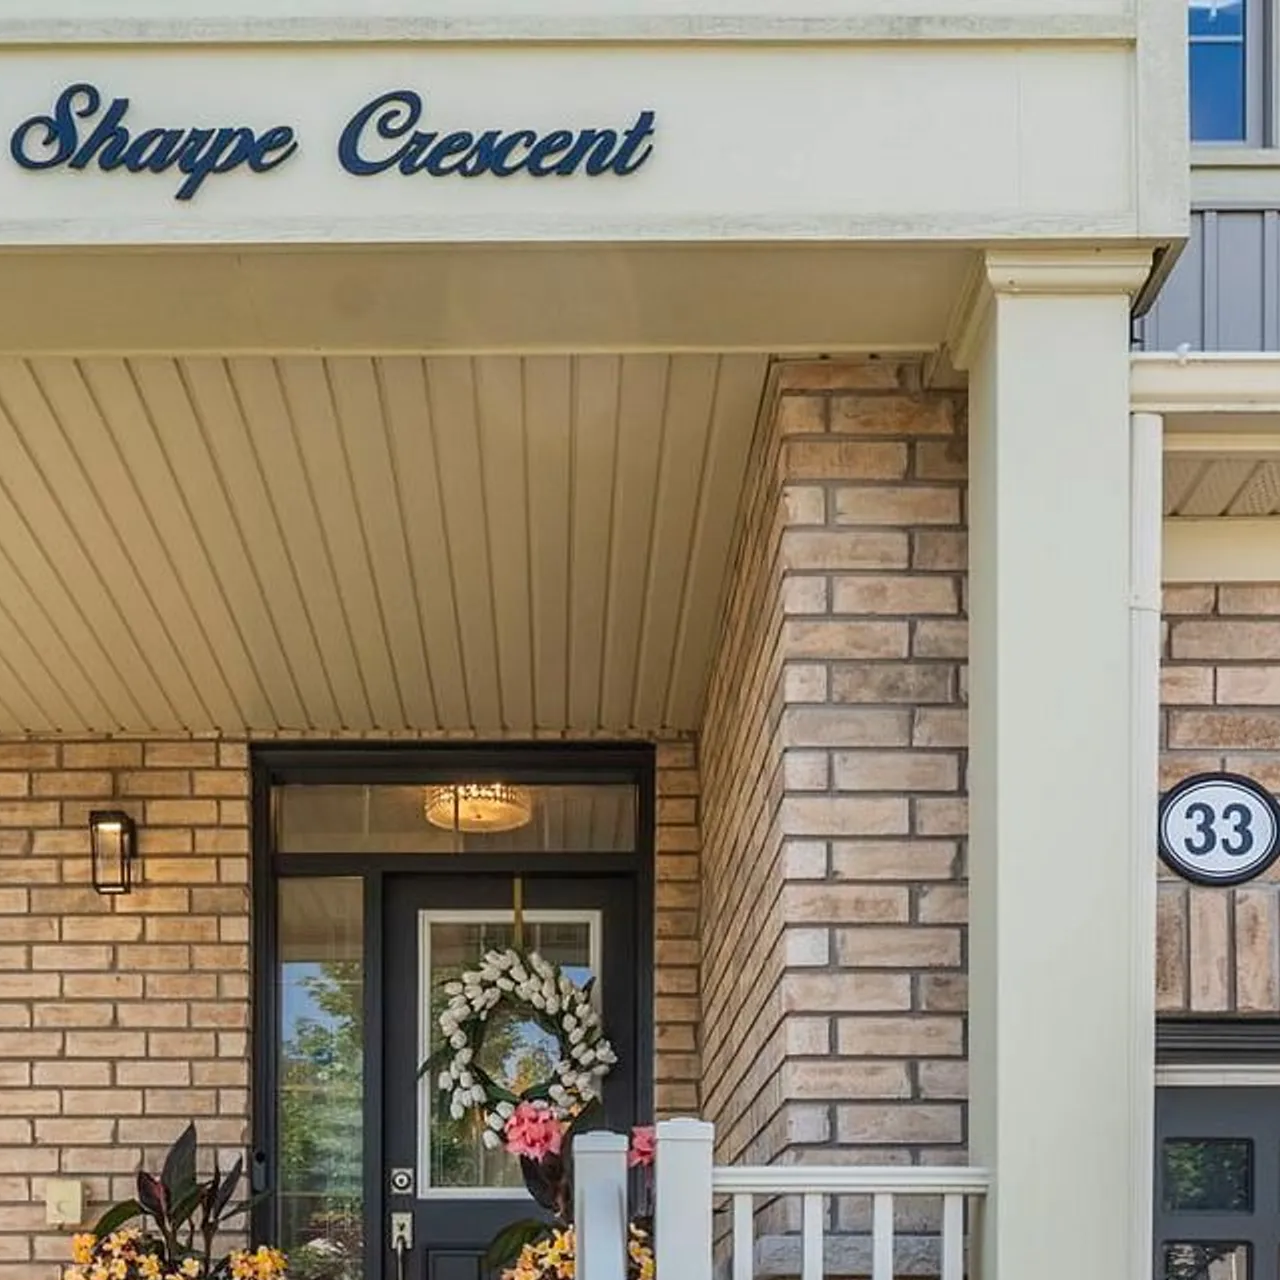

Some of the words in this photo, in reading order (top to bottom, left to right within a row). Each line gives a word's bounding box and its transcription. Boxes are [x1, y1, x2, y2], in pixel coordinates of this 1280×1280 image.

[10, 83, 298, 201] Sharpe
[337, 90, 655, 178] Crescent
[1184, 802, 1254, 856] 33
